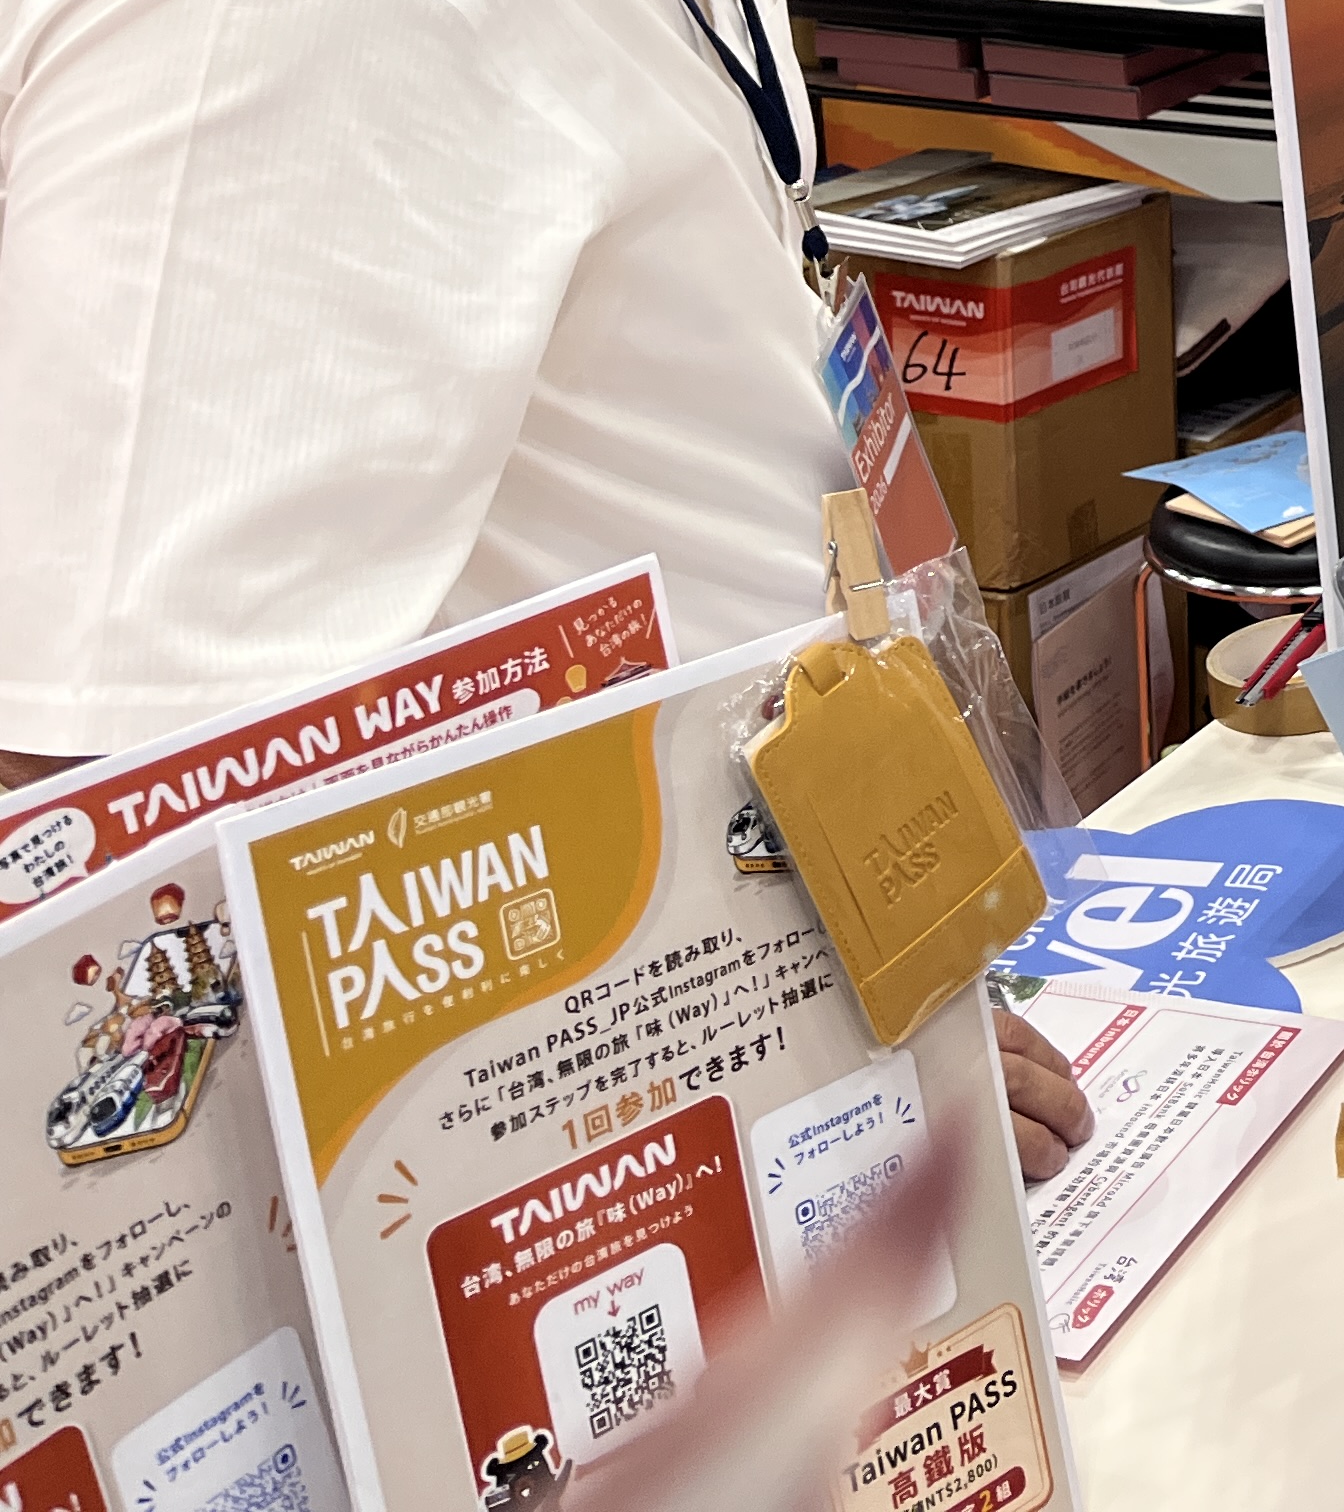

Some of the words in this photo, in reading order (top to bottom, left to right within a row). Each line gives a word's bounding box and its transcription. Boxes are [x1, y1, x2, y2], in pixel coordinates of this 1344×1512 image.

[890, 289, 985, 320] TAIWAN
[902, 330, 966, 391] 64
[854, 392, 895, 484] Exhibitor
[573, 596, 618, 636] 見つかる
[107, 715, 341, 835] TAIWAN
[354, 674, 444, 740] WAY
[451, 647, 549, 706] 参加方法
[289, 829, 376, 872] TAIWAN
[306, 824, 550, 959] TAIWAN
[1046, 853, 1224, 992] vel
[327, 920, 486, 1029] PASS
[564, 928, 744, 1015] QRコードを読み取り、
[464, 1045, 541, 1088] Taiwan
[787, 1093, 884, 1149] 公式Instagramを
[1114, 1101, 1153, 1140] inbound
[1153, 1080, 1193, 1121] SoftBank
[490, 1133, 677, 1245] TAIWAN
[1052, 1174, 1108, 1229] CyberAgent
[1095, 1170, 1135, 1208] MicroAd
[0, 1201, 190, 1328] nstagramをフォローし、
[572, 1289, 602, 1316] my
[606, 1267, 645, 1302] way
[893, 1369, 952, 1419] 最大賞
[843, 1421, 943, 1493] Taiwan
[949, 1369, 1018, 1431] PASS
[887, 1423, 988, 1510] 高鐵版
